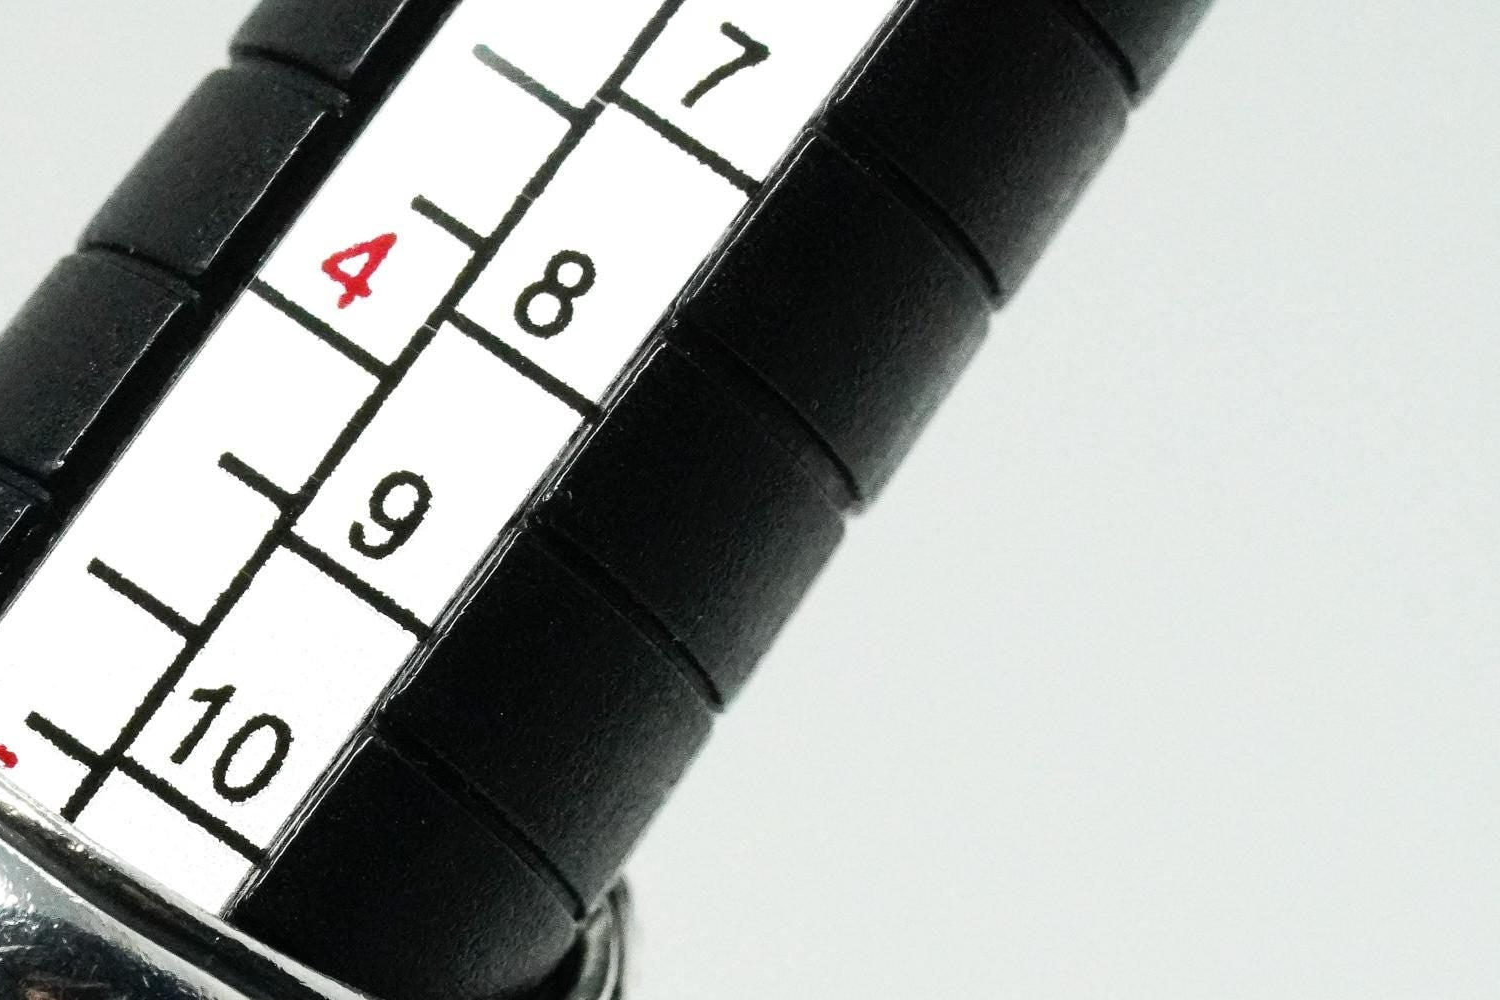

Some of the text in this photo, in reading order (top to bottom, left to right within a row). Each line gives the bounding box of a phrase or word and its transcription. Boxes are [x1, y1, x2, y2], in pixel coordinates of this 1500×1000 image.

[681, 22, 771, 108] 7
[321, 232, 398, 309] 4
[513, 250, 597, 339] 8
[348, 470, 433, 560] 9
[171, 685, 295, 804] 10
